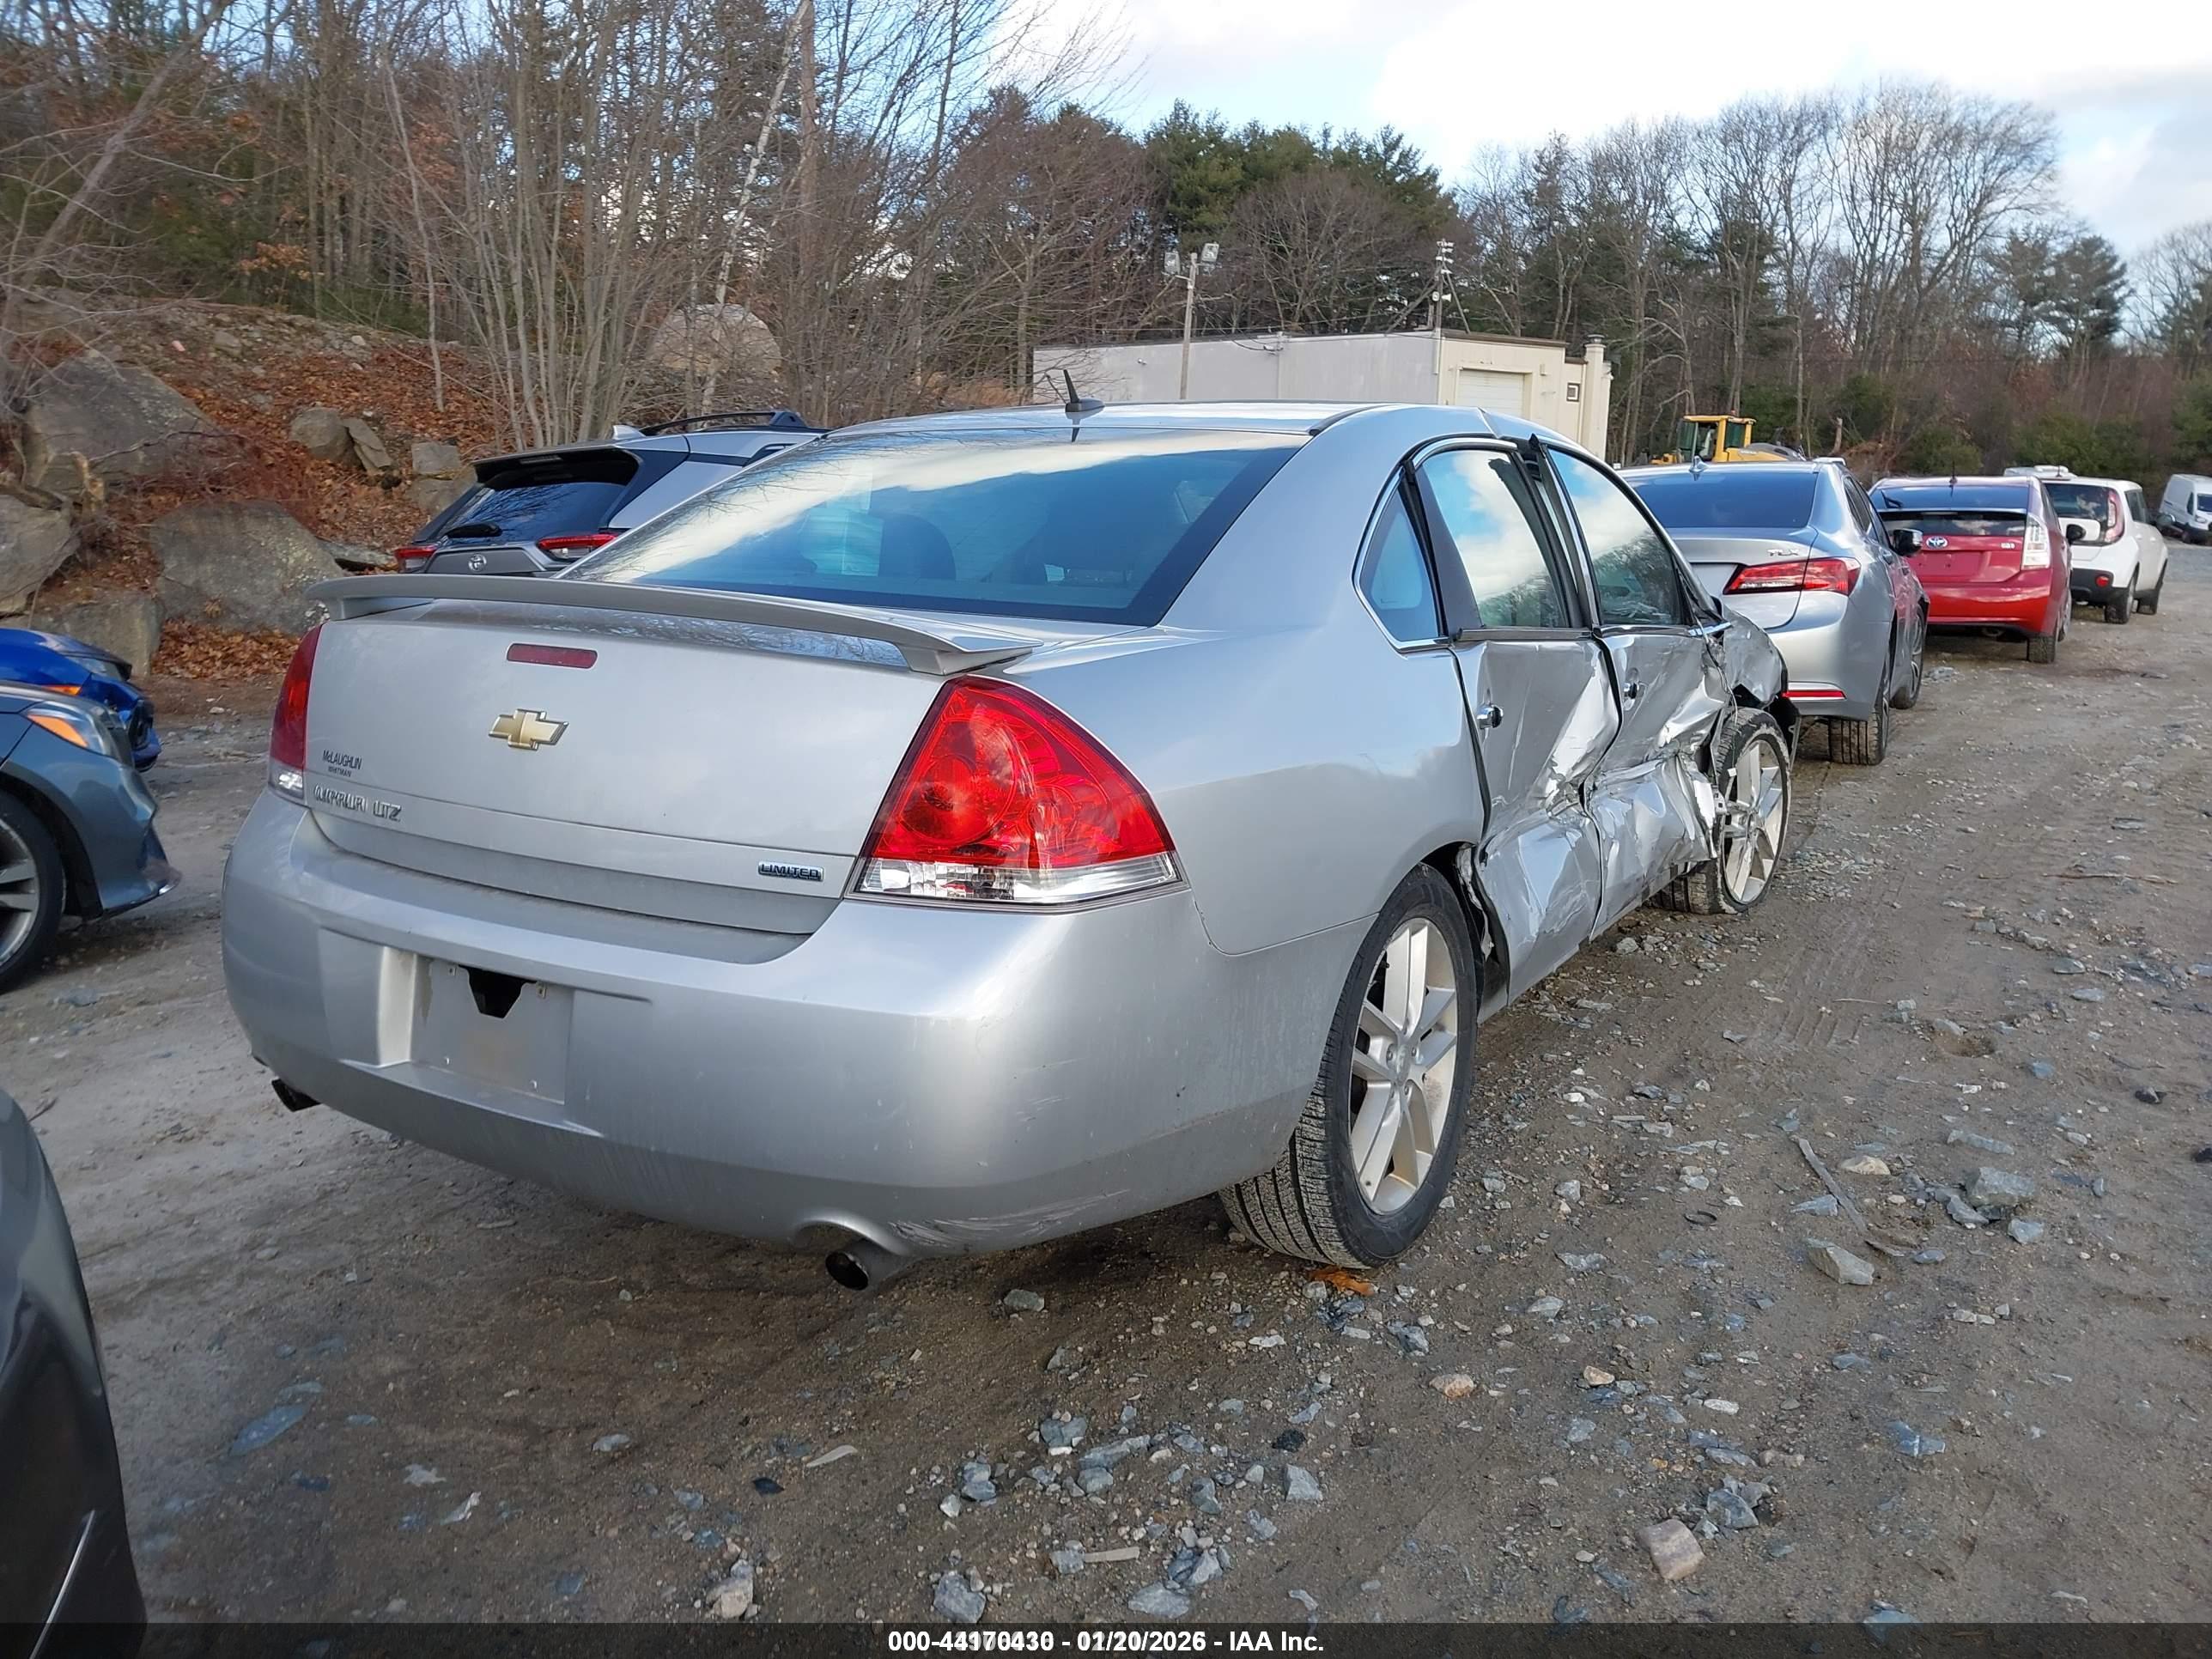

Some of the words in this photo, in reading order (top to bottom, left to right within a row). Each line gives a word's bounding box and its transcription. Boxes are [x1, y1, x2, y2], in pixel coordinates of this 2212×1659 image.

[1766, 548, 1799, 557] TLX
[322, 749, 362, 770] McLAUGHLIN
[373, 800, 402, 823] LTZ
[760, 863, 821, 880] LIMITED
